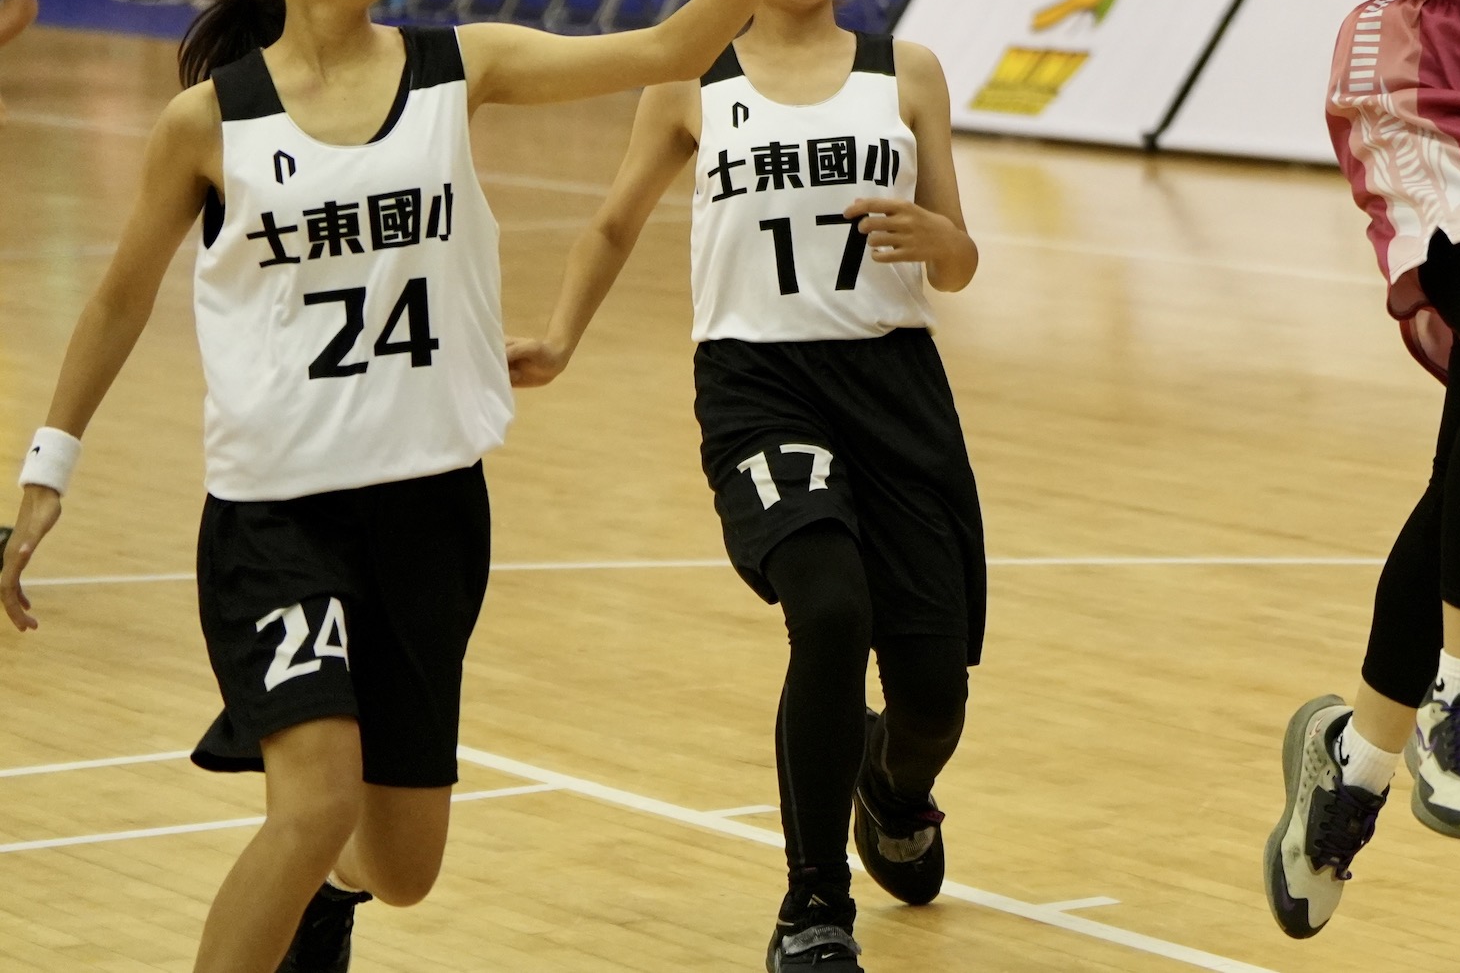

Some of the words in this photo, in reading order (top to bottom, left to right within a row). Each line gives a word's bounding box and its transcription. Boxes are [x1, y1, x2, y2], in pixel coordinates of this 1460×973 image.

[706, 135, 900, 203] 士東國小
[245, 182, 454, 268] 士東國小
[758, 213, 869, 296] 17
[302, 276, 440, 380] 24
[736, 443, 834, 511] 17
[255, 596, 350, 692] 24
